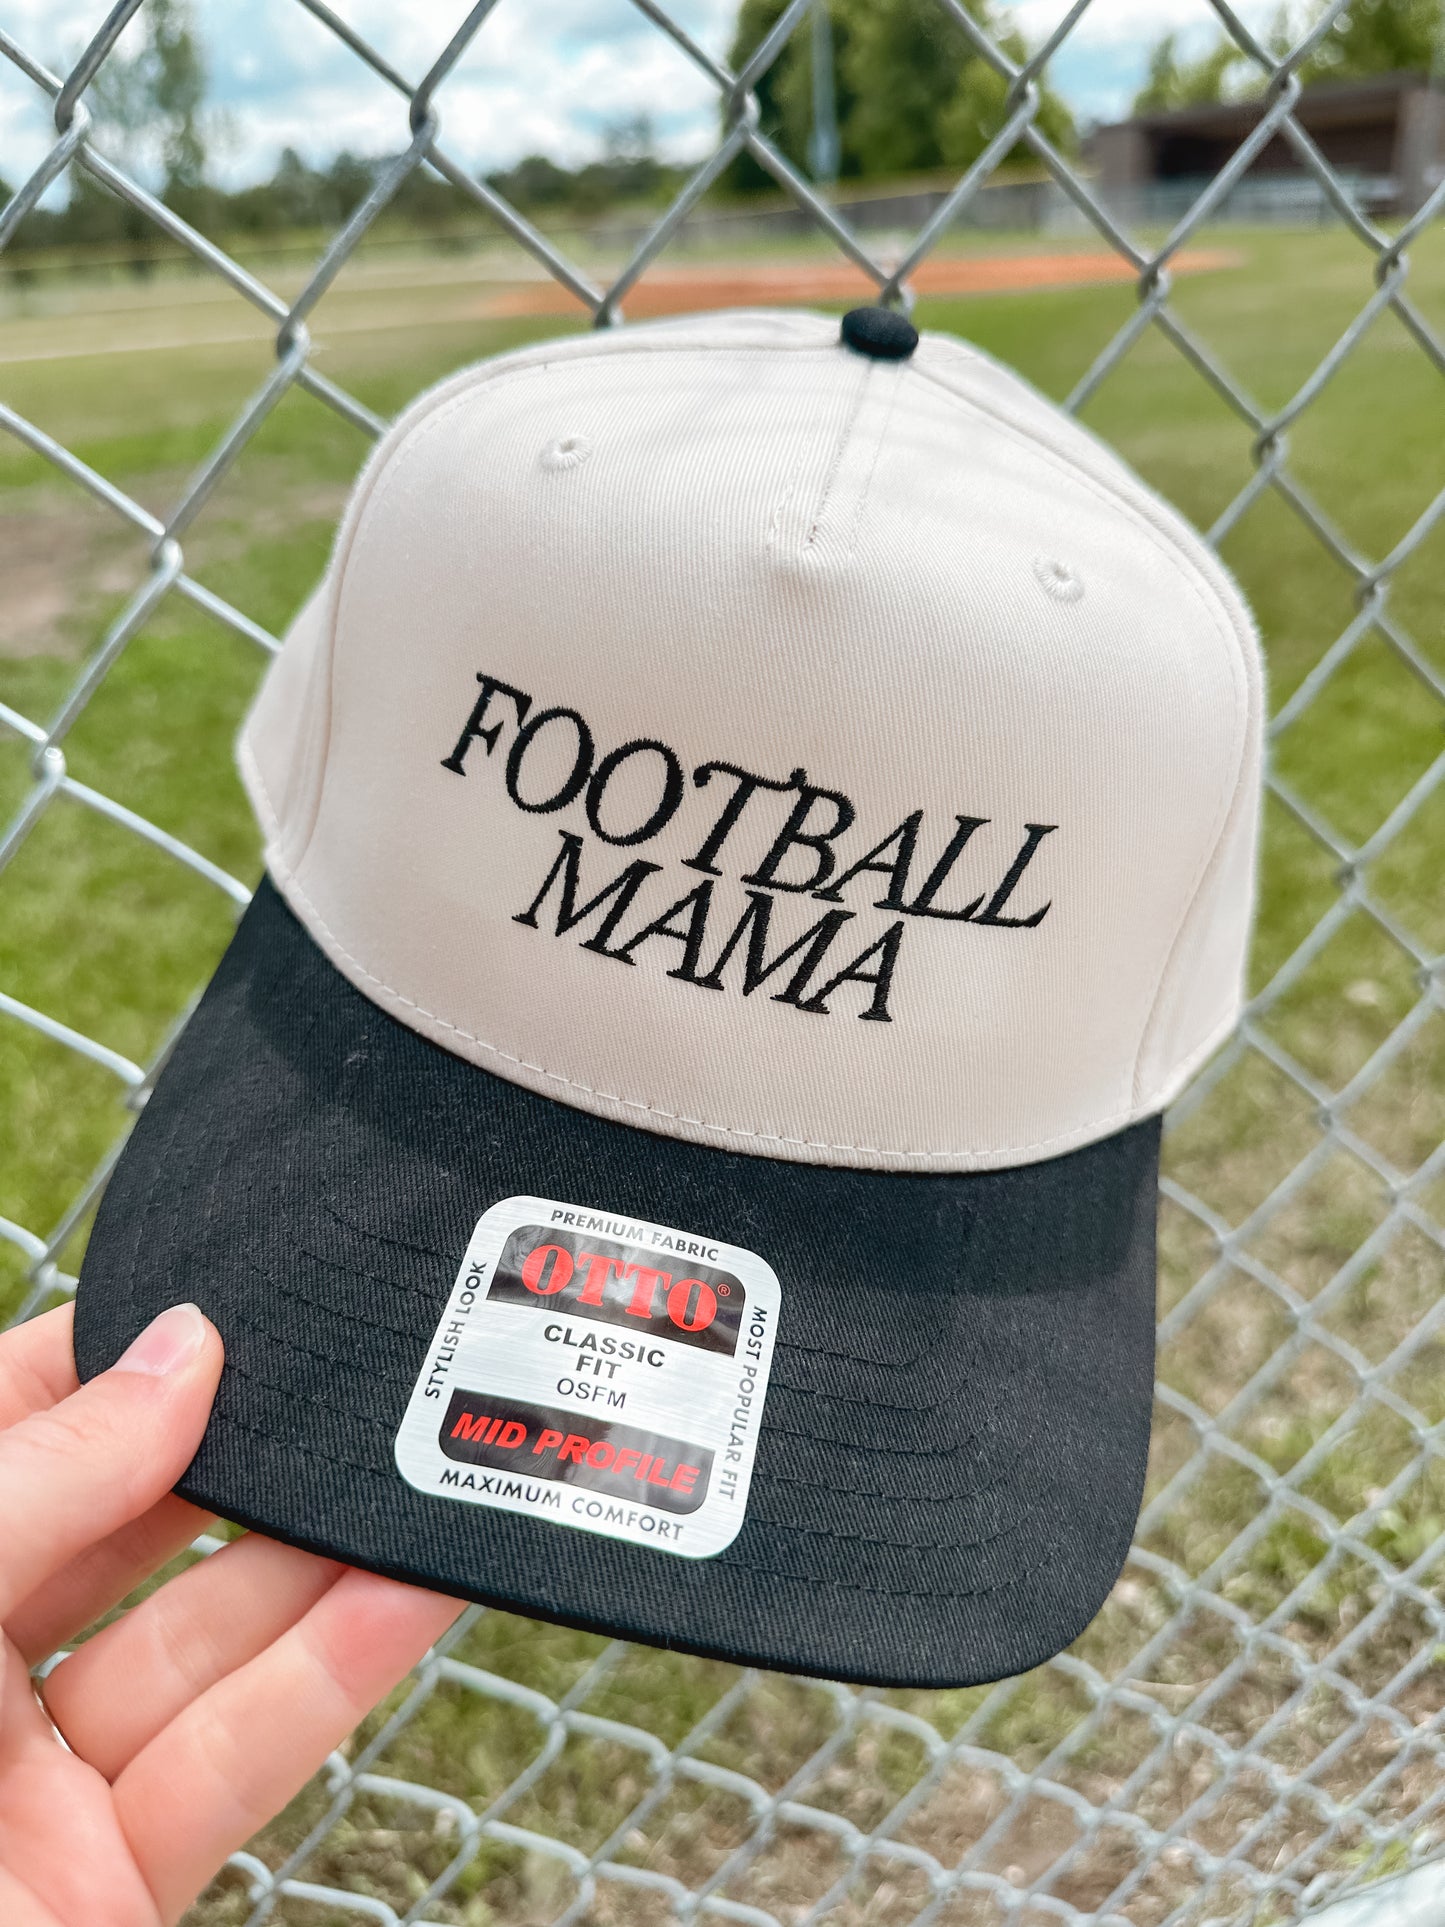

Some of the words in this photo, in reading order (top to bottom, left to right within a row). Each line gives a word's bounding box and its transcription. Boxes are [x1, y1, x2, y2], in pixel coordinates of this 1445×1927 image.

[440, 671, 1059, 929] FOOTBALL
[511, 829, 905, 1022] MAMA
[551, 1209, 644, 1242] PREMIUM
[651, 1232, 720, 1262] FABRIC
[424, 1316, 466, 1399] STYLISH
[455, 1261, 487, 1316] LOOK
[543, 1324, 665, 1369] CLASSIC
[744, 1305, 768, 1360] MOST
[556, 1378, 627, 1410] OSFM
[575, 1355, 622, 1379] FIT
[725, 1364, 758, 1463] POPULAR
[450, 1413, 527, 1449] MID
[532, 1429, 700, 1495] PROFILE
[719, 1468, 738, 1501] FIT
[439, 1469, 561, 1509] MAXIMUM
[572, 1497, 684, 1541] COMFORT
